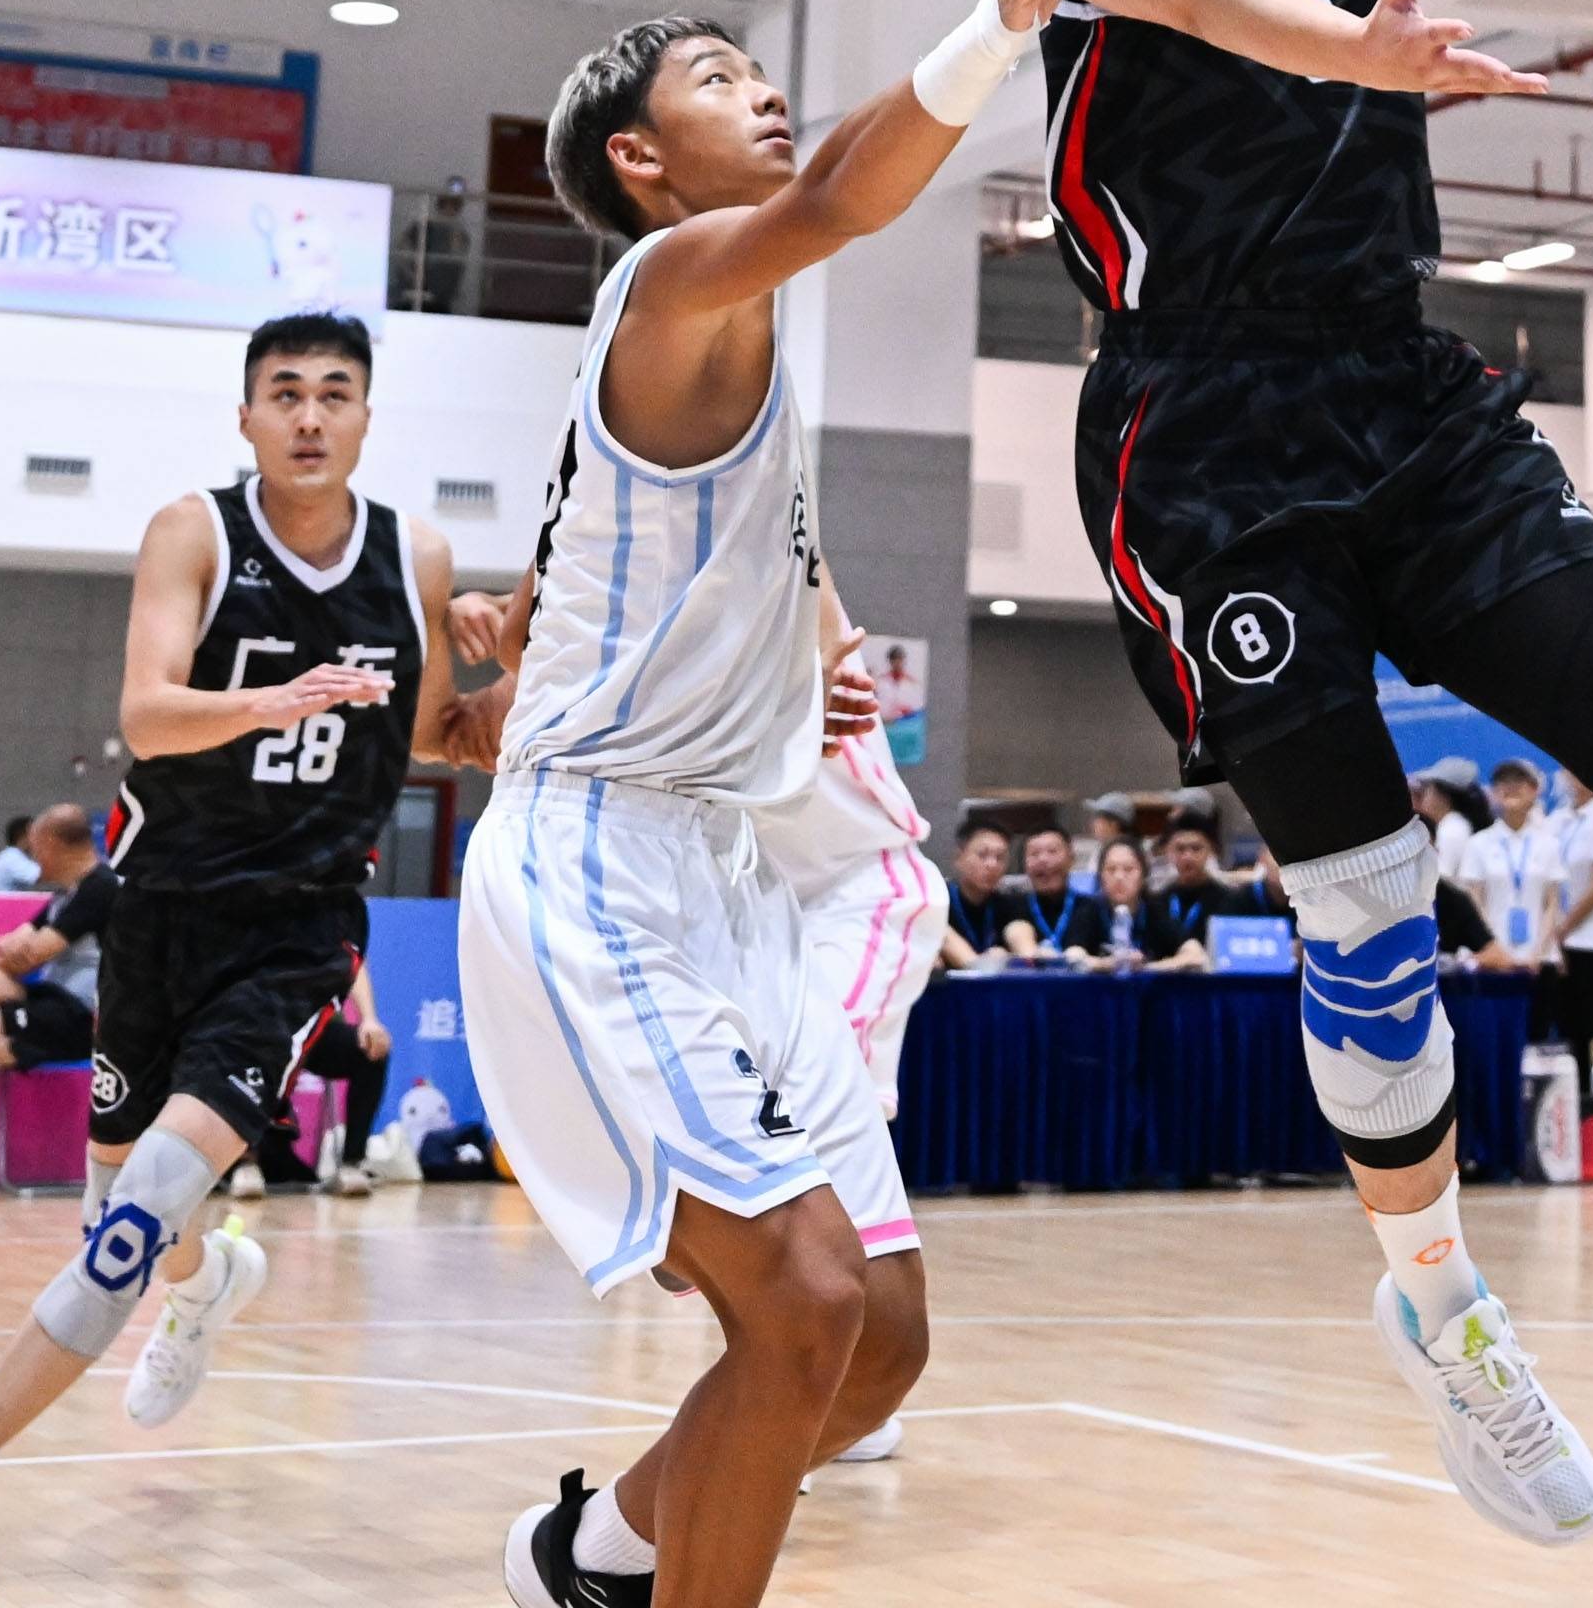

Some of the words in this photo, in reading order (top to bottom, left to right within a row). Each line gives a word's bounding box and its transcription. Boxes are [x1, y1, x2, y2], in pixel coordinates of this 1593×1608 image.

[1229, 611, 1271, 664] 8
[252, 712, 346, 784] 28
[413, 998, 464, 1042] 追
